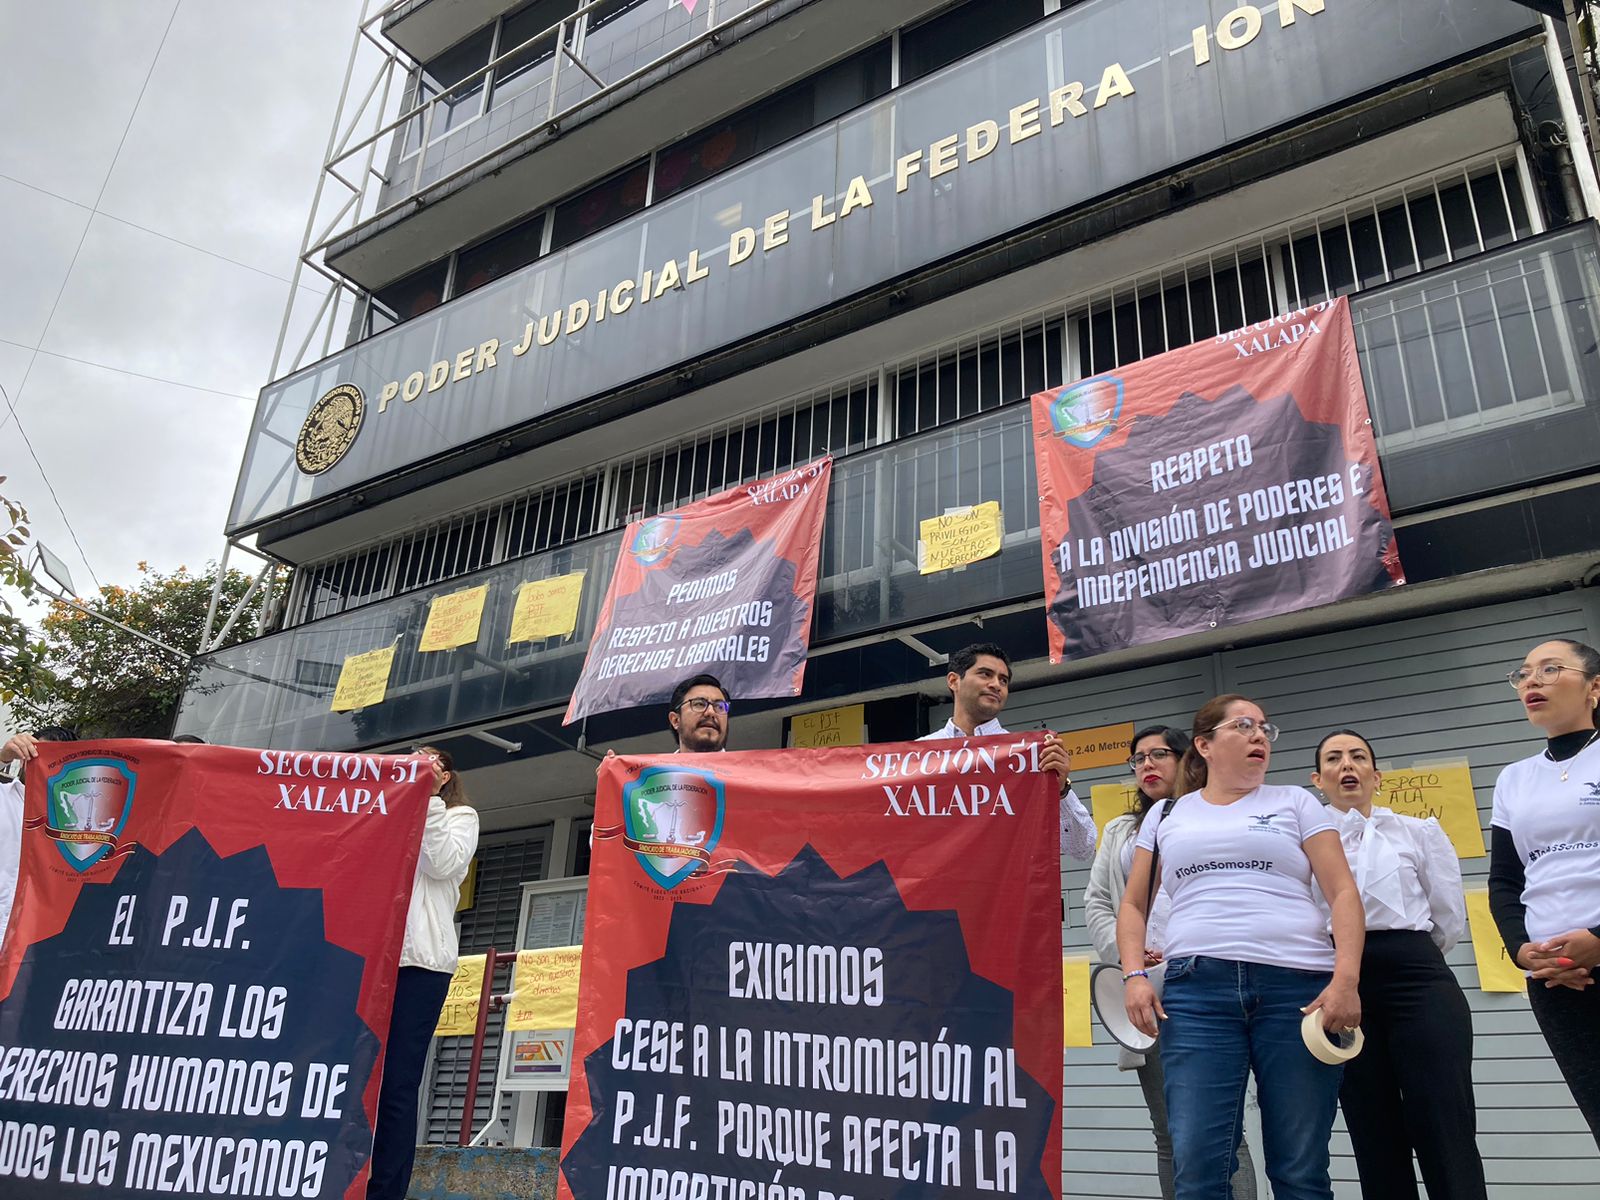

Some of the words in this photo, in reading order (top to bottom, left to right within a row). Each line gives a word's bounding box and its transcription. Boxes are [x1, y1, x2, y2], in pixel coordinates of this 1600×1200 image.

[378, 338, 499, 414] PODER
[512, 249, 709, 356] JUDICIAL
[728, 209, 790, 266] DE
[811, 175, 873, 231] LA
[1234, 320, 1321, 360] XALAPA
[1151, 434, 1253, 493] RESPETO
[938, 516, 952, 529] NO
[1059, 541, 1072, 573] A
[1078, 536, 1105, 568] LA
[1110, 504, 1200, 562] DIVISIÓN
[1204, 498, 1230, 535] DE
[1237, 473, 1344, 526] PODERES
[1350, 463, 1364, 496] E
[1077, 541, 1242, 609] INDEPENDENCIA
[1248, 515, 1354, 569] JUDICIAL
[667, 569, 738, 605] PEDIMOS
[609, 621, 676, 650] RESPETO
[678, 619, 691, 640] A
[691, 600, 773, 638] NUESTROS
[597, 653, 673, 680] DERECHOS
[675, 635, 770, 668] LABORALES
[861, 741, 999, 780] SECCIÓN
[1008, 738, 1040, 773] 51
[1076, 743, 1096, 756] 2.40
[1098, 739, 1132, 752] Metros
[390, 757, 418, 784] 51
[1380, 774, 1439, 792] ESPETO
[273, 783, 388, 816] XALAPA
[882, 783, 1015, 816] XALAPA
[1404, 787, 1424, 804] LA
[1175, 860, 1273, 879] #TodosSomosPJF
[108, 894, 137, 945] EL
[161, 895, 250, 950] P.J.F.
[728, 942, 884, 1006] EXIGIMOS
[53, 978, 214, 1036] GARANTIZA
[219, 984, 288, 1040] LOS
[0, 1045, 118, 1107] ERECHOS
[122, 1054, 294, 1117] HUMANOS
[301, 1062, 349, 1119] DE
[611, 1018, 684, 1074] CESE
[692, 1024, 708, 1078] A
[720, 1026, 753, 1083] LA
[763, 1027, 972, 1104] INTROMISIÓN
[983, 1047, 1027, 1108] AL
[0, 1120, 56, 1181] DOS
[60, 1127, 120, 1186] LOS
[125, 1132, 328, 1198] MEXICANOS
[612, 1090, 697, 1151] P.J.F.
[717, 1100, 831, 1168] PORQUE
[842, 1115, 961, 1187] AFECTA
[974, 1128, 1017, 1193] LA
[606, 1165, 807, 1200] IMPART
